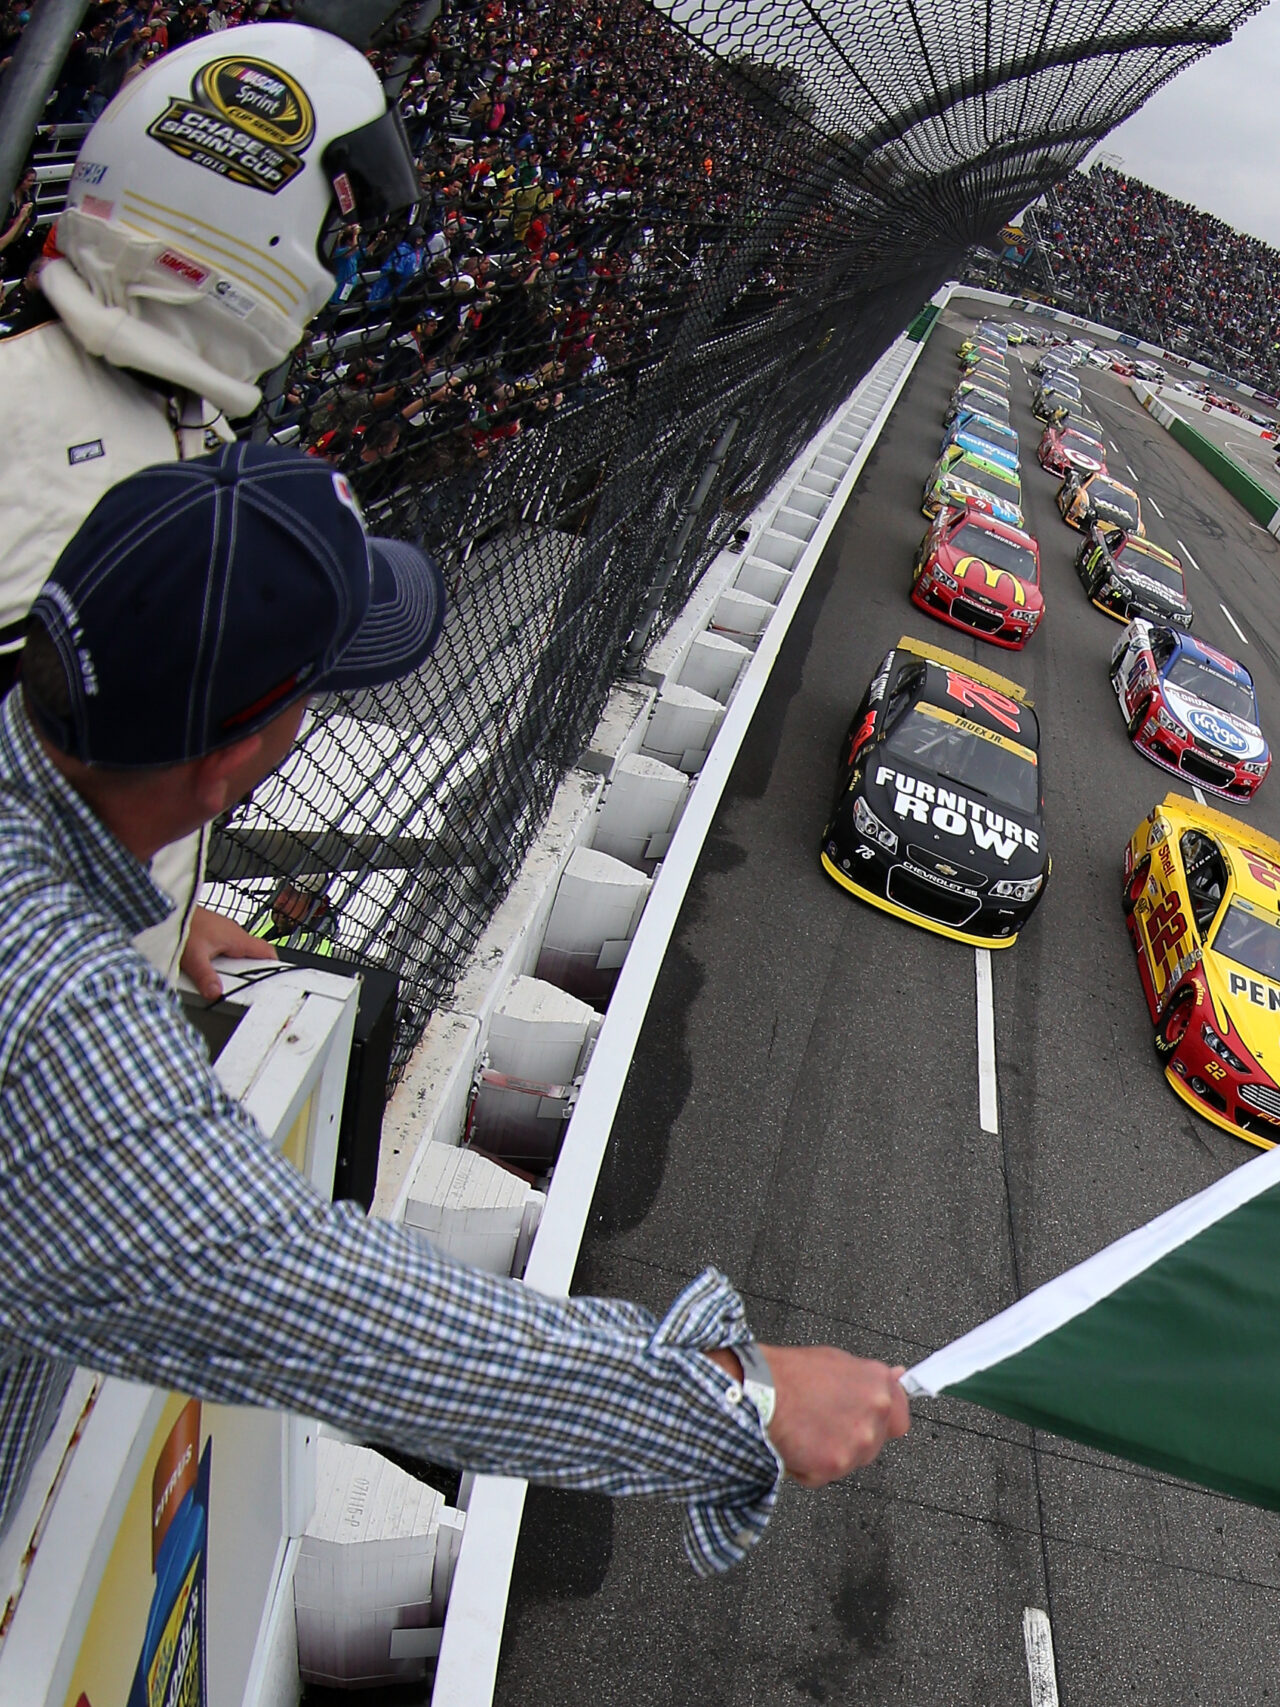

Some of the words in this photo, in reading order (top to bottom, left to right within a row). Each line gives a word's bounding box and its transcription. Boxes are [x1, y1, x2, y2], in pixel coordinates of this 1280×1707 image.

[235, 85, 281, 115] Sprint
[240, 71, 287, 97] NASCAR
[181, 112, 265, 155] CHASE
[227, 107, 254, 122] CUP
[254, 118, 286, 142] SERIES
[160, 120, 244, 158] SPRINT
[240, 155, 282, 182] CUP
[158, 254, 205, 282] SIMPSON
[984, 530, 1022, 550] McMURRAY
[954, 716, 986, 738] TRUEX
[988, 731, 1004, 745] JR.
[1193, 712, 1246, 750] Kroger
[875, 766, 1040, 853] FURNITURE
[893, 791, 1019, 861] ROW
[854, 844, 876, 860] 78
[1158, 843, 1178, 879] Shell
[903, 861, 963, 892] CHEVROLET
[1146, 890, 1187, 967] 22
[1203, 1060, 1228, 1081] 22
[343, 1478, 370, 1528] 071115-P
